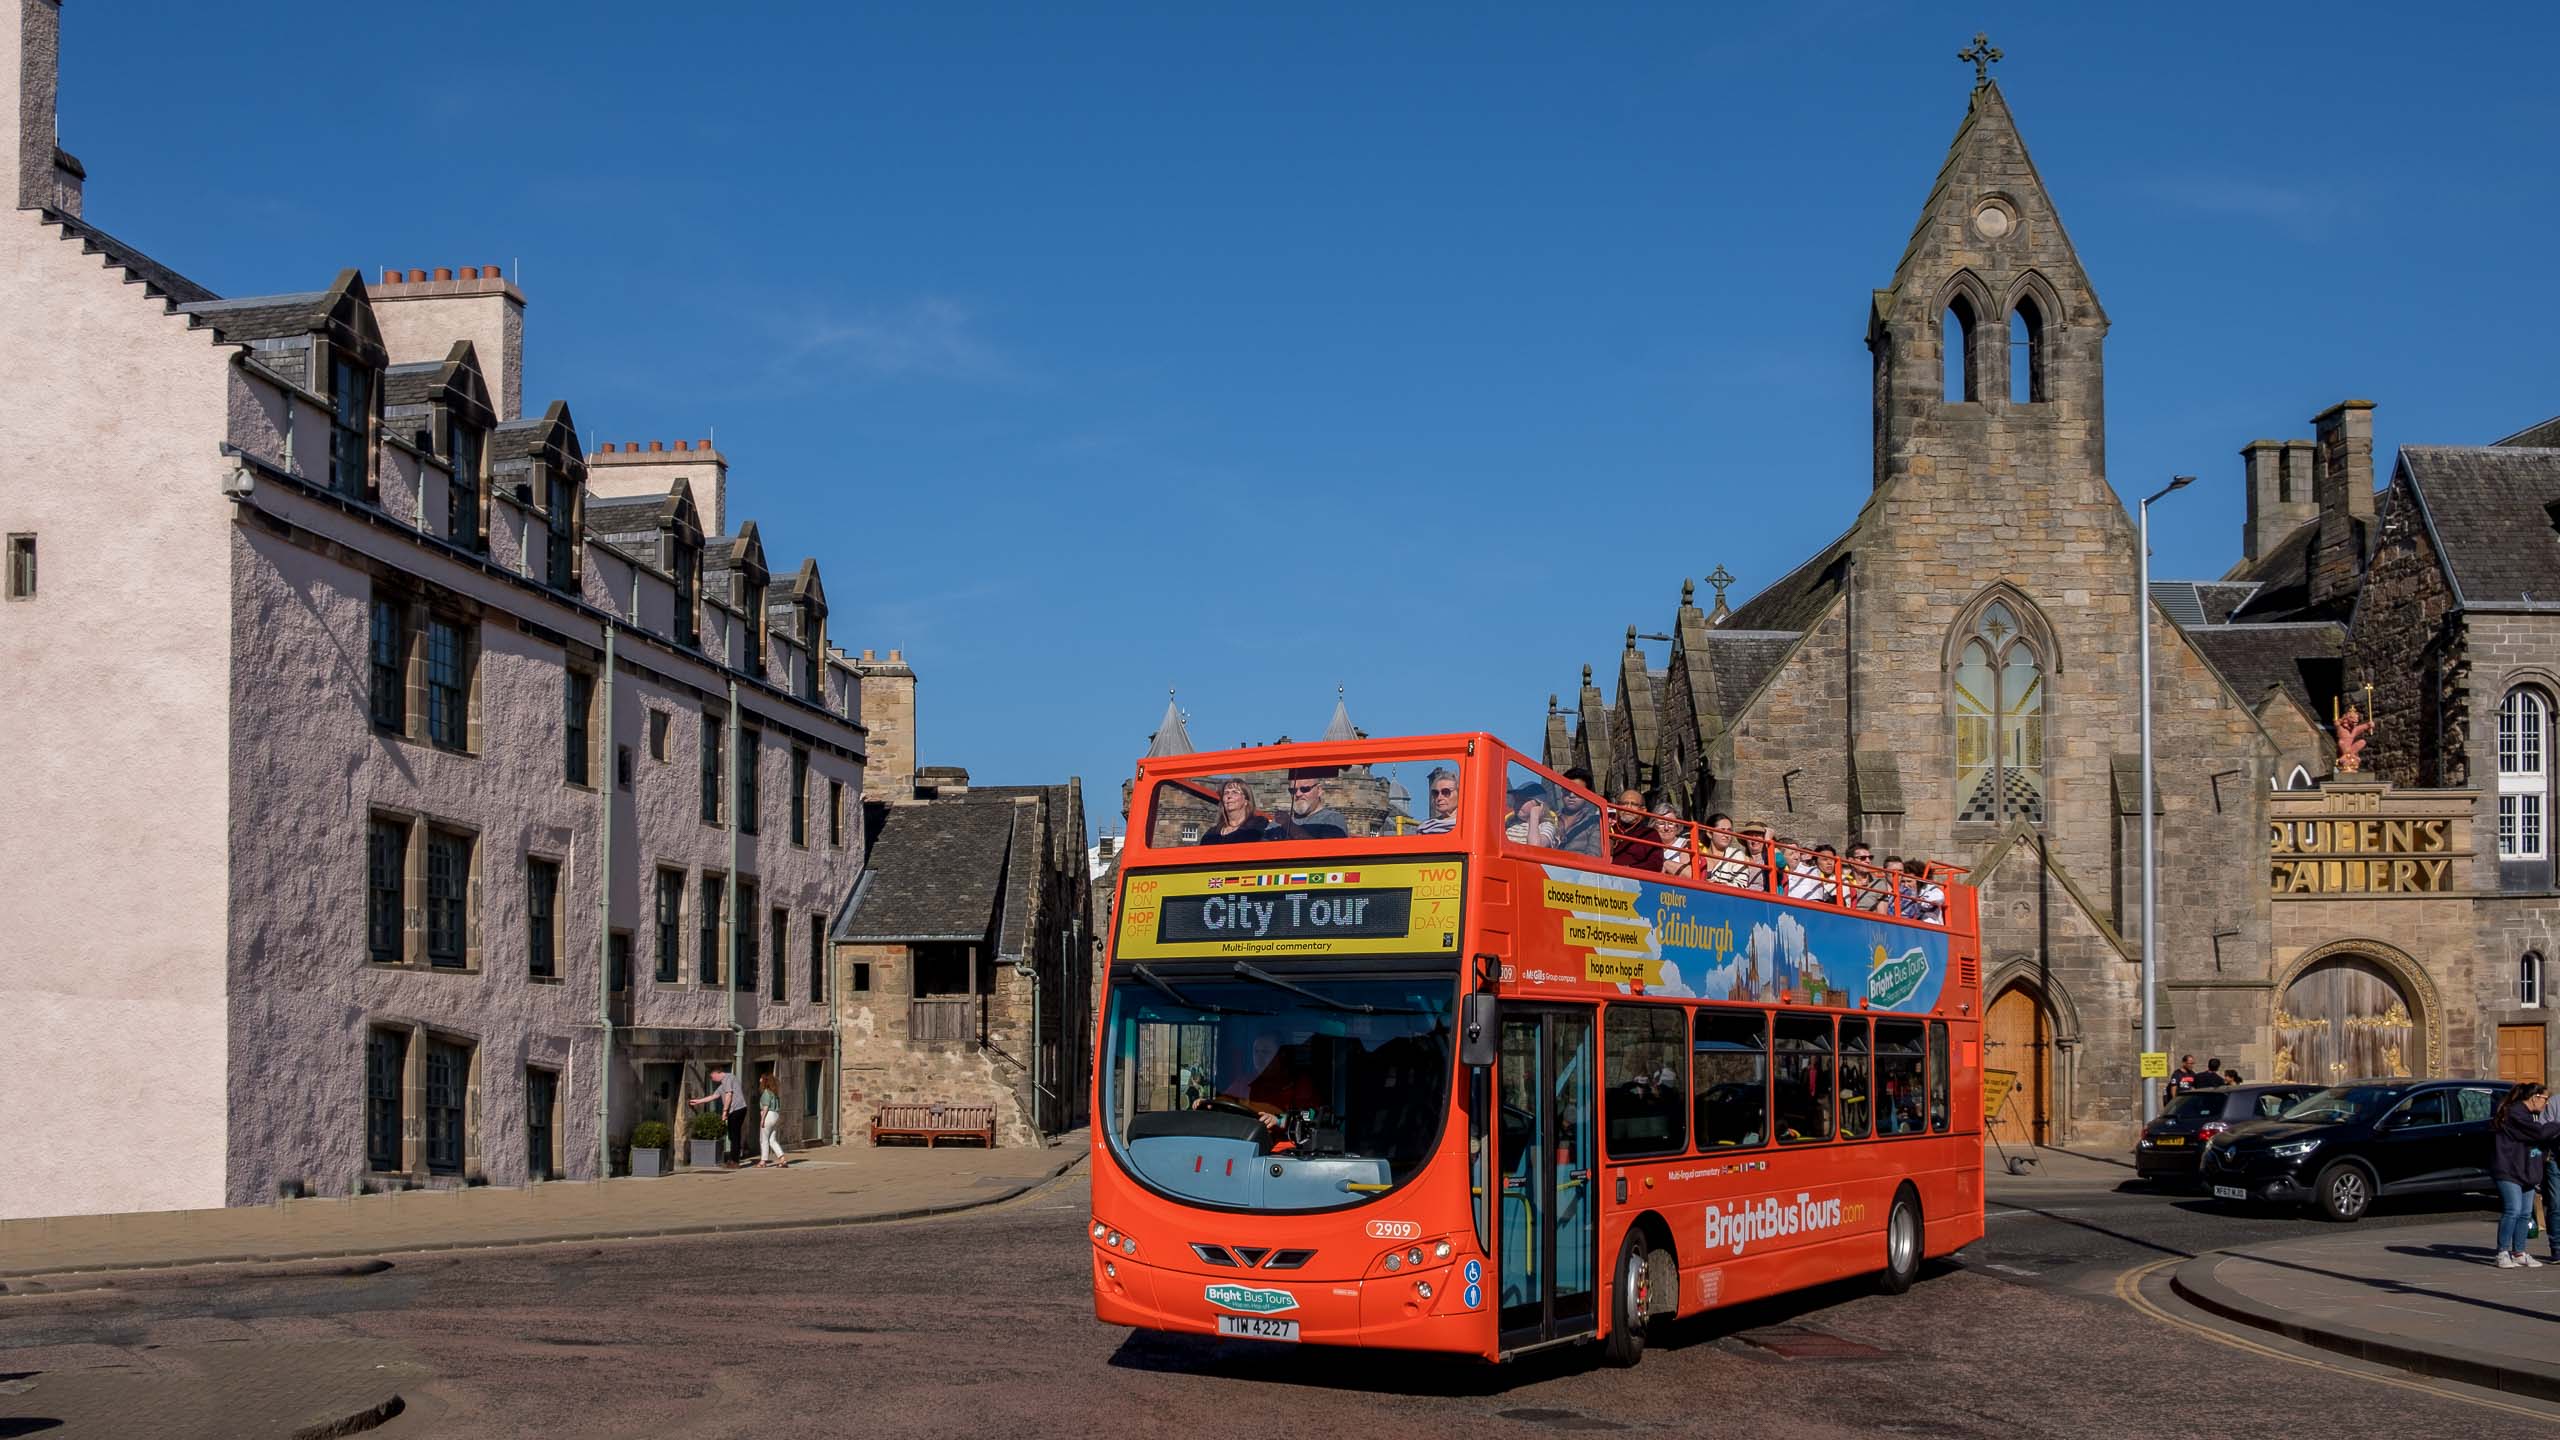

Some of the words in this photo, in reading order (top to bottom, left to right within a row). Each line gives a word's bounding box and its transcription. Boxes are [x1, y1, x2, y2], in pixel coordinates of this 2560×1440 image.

[2271, 820, 2445, 853] QUEEN'S
[1419, 868, 1457, 881] TWO
[1131, 880, 1158, 893] HOP
[1414, 884, 1460, 897] TOURS
[1133, 894, 1153, 907] ON
[1431, 901, 1441, 914] 7
[1547, 886, 1574, 904] choose
[1575, 890, 1593, 907] from
[1594, 893, 1609, 908] two
[1609, 896, 1629, 912] tours
[1660, 889, 1687, 911] explore
[1128, 912, 1154, 924] HOP
[1203, 894, 1275, 937] City
[1285, 893, 1369, 927] Tour
[1414, 915, 1456, 930] DAYS
[1126, 924, 1153, 938] OFF
[1569, 927, 1586, 940] runs
[1586, 926, 1639, 945] 7-days-a-week
[1656, 908, 1734, 962] Edinburgh
[1222, 942, 1274, 953] Multi-lingual
[1275, 941, 1332, 952] commentary
[1590, 959, 1604, 977] hop
[1605, 966, 1615, 975] on
[1619, 964, 1633, 982] hop
[1633, 964, 1644, 978] off
[1870, 971, 1894, 999] Bright
[1893, 966, 1907, 985] Bus
[1906, 958, 1925, 976] Tours
[1375, 1222, 1411, 1237] 2909
[1705, 1193, 1865, 1256] BrightBusTours.com
[1209, 1288, 1242, 1302] Bright
[1243, 1292, 1263, 1303] Bus
[1263, 1292, 1293, 1305] Tours
[1227, 1316, 1249, 1334] TIW
[1252, 1320, 1290, 1337] 4227
